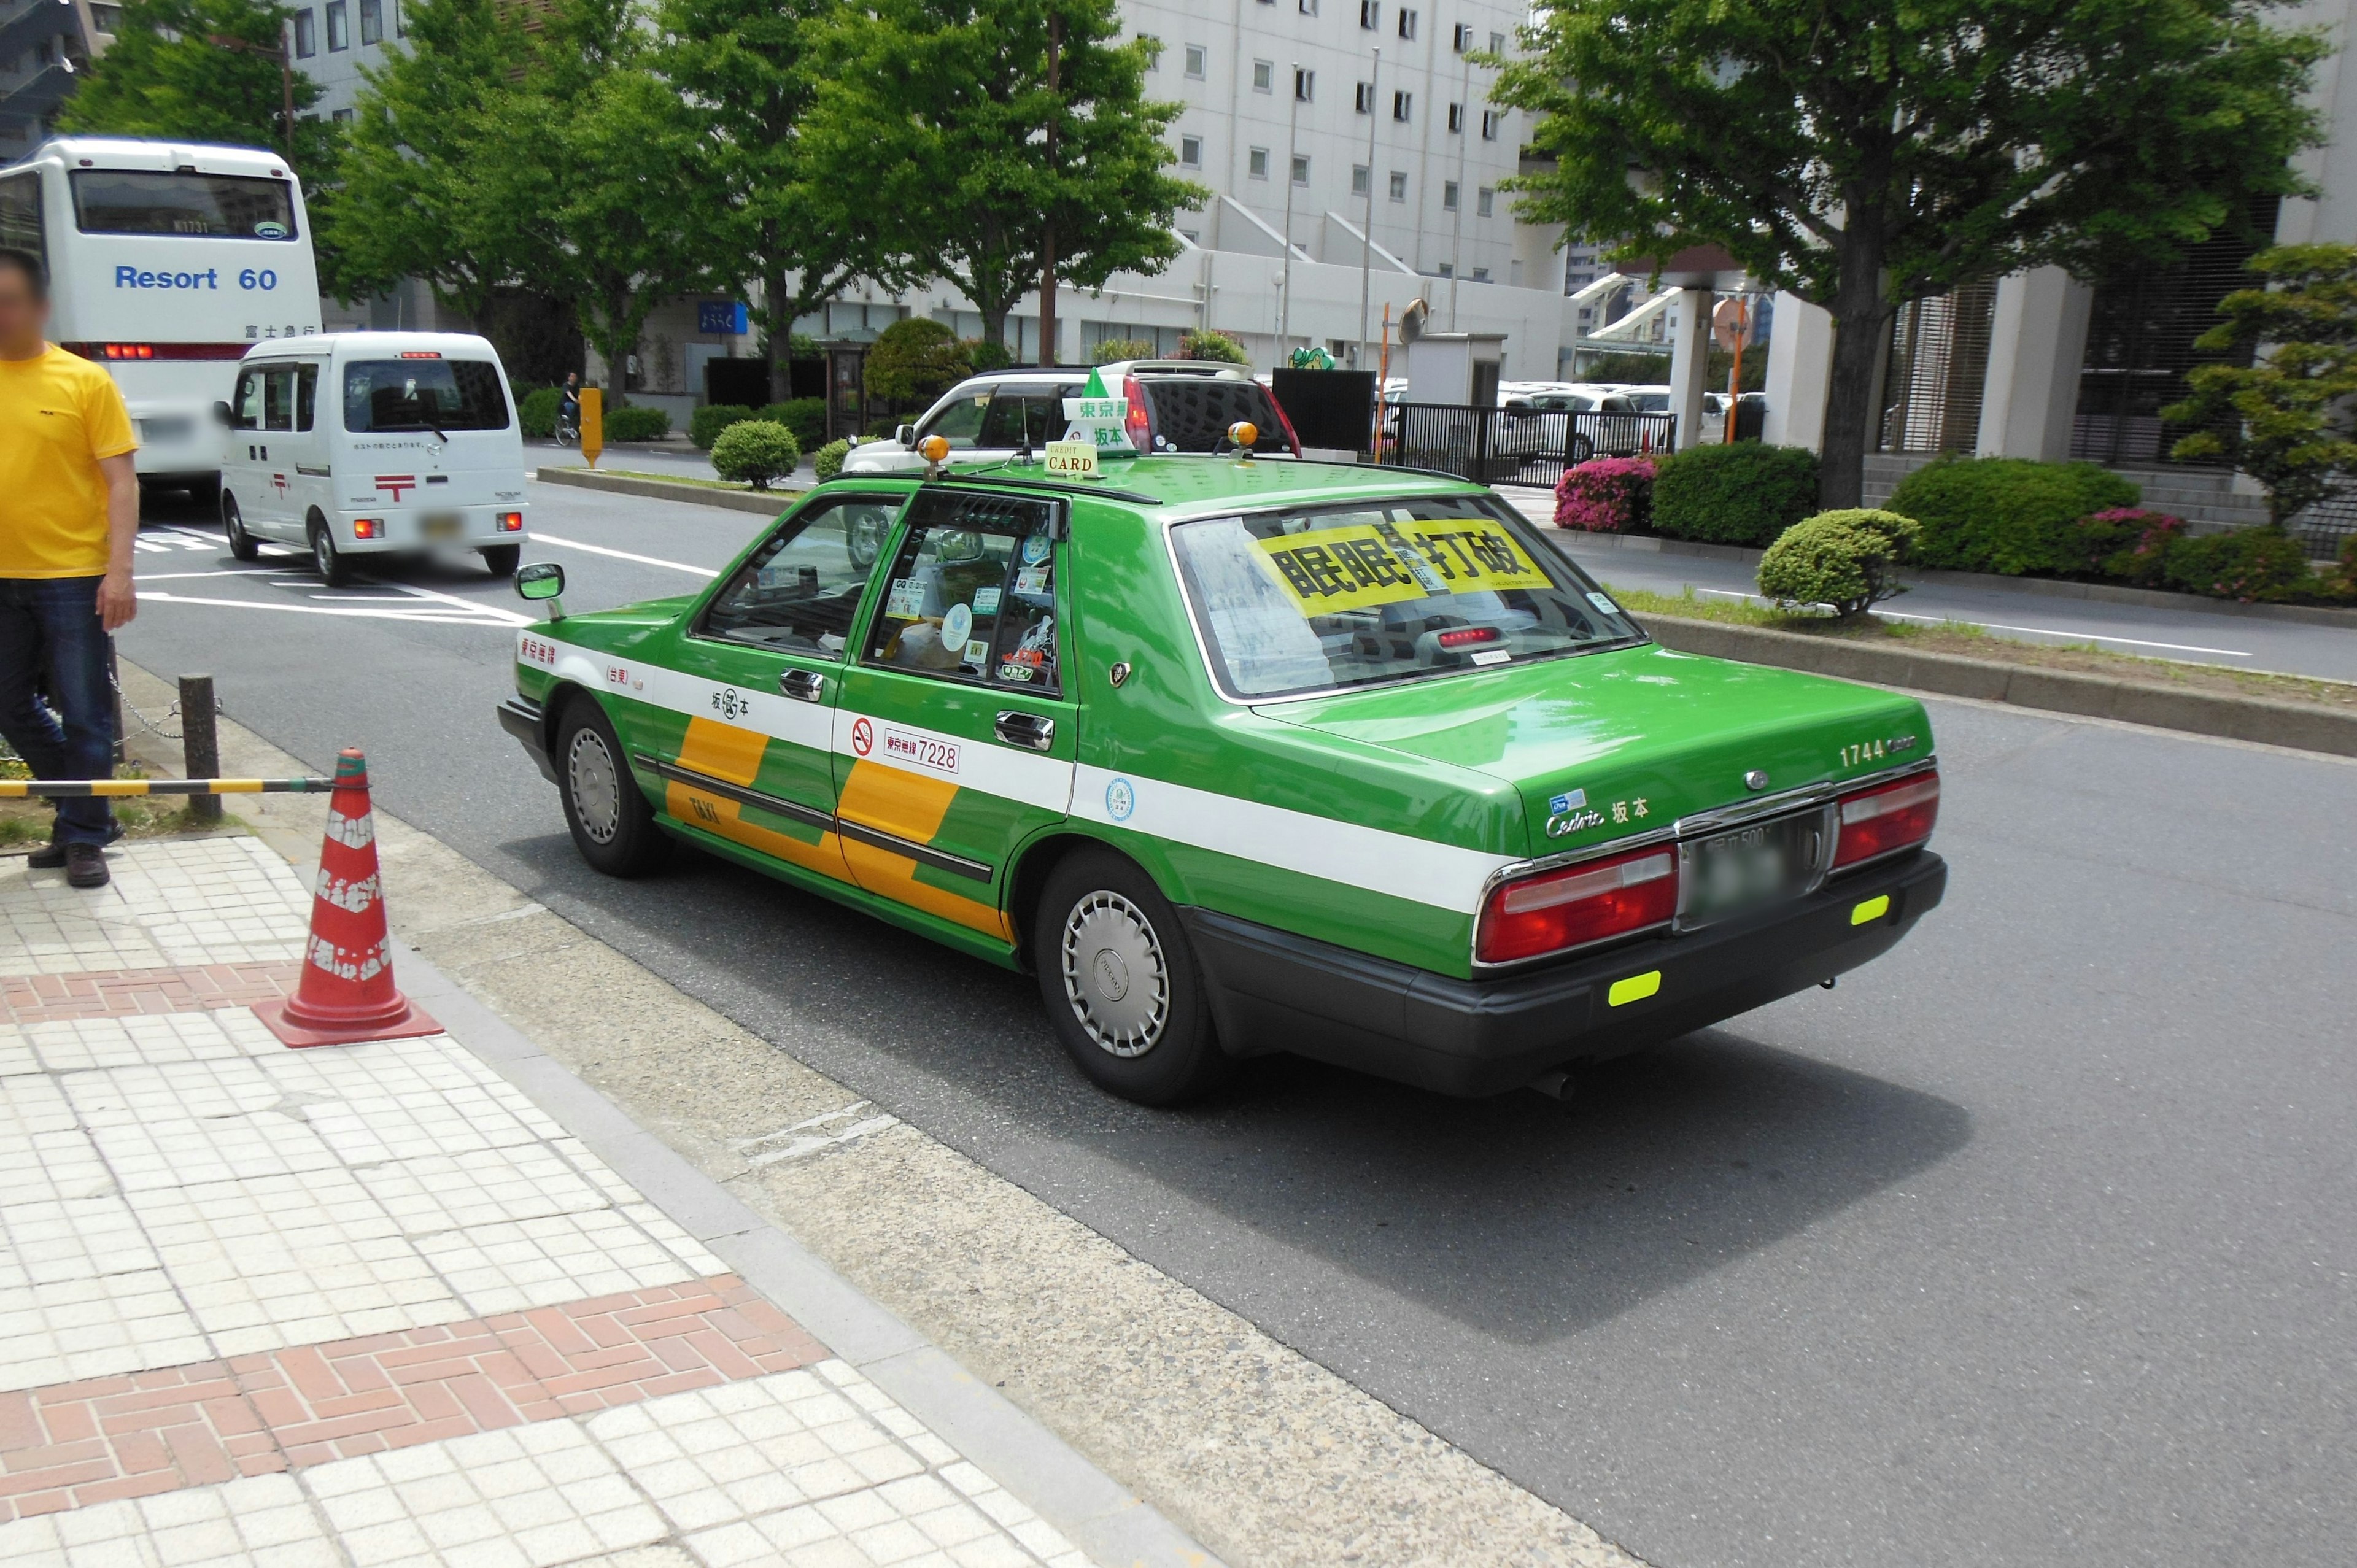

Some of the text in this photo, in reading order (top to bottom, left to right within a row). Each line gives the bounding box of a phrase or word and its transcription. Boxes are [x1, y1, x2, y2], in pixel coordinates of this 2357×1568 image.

[115, 266, 277, 290] Resort 60
[246, 325, 314, 338] 富士急行
[1094, 427, 1123, 446] 坂本
[1050, 446, 1077, 454] CREDIT
[1049, 457, 1092, 472] CARD
[521, 638, 555, 665] 東京無線
[606, 665, 628, 685] (台東)
[887, 736, 956, 768] 東京無線 7228
[1840, 739, 1884, 767] 1744
[689, 797, 721, 825] TAXI
[1546, 797, 1649, 838] Cedric 坂本
